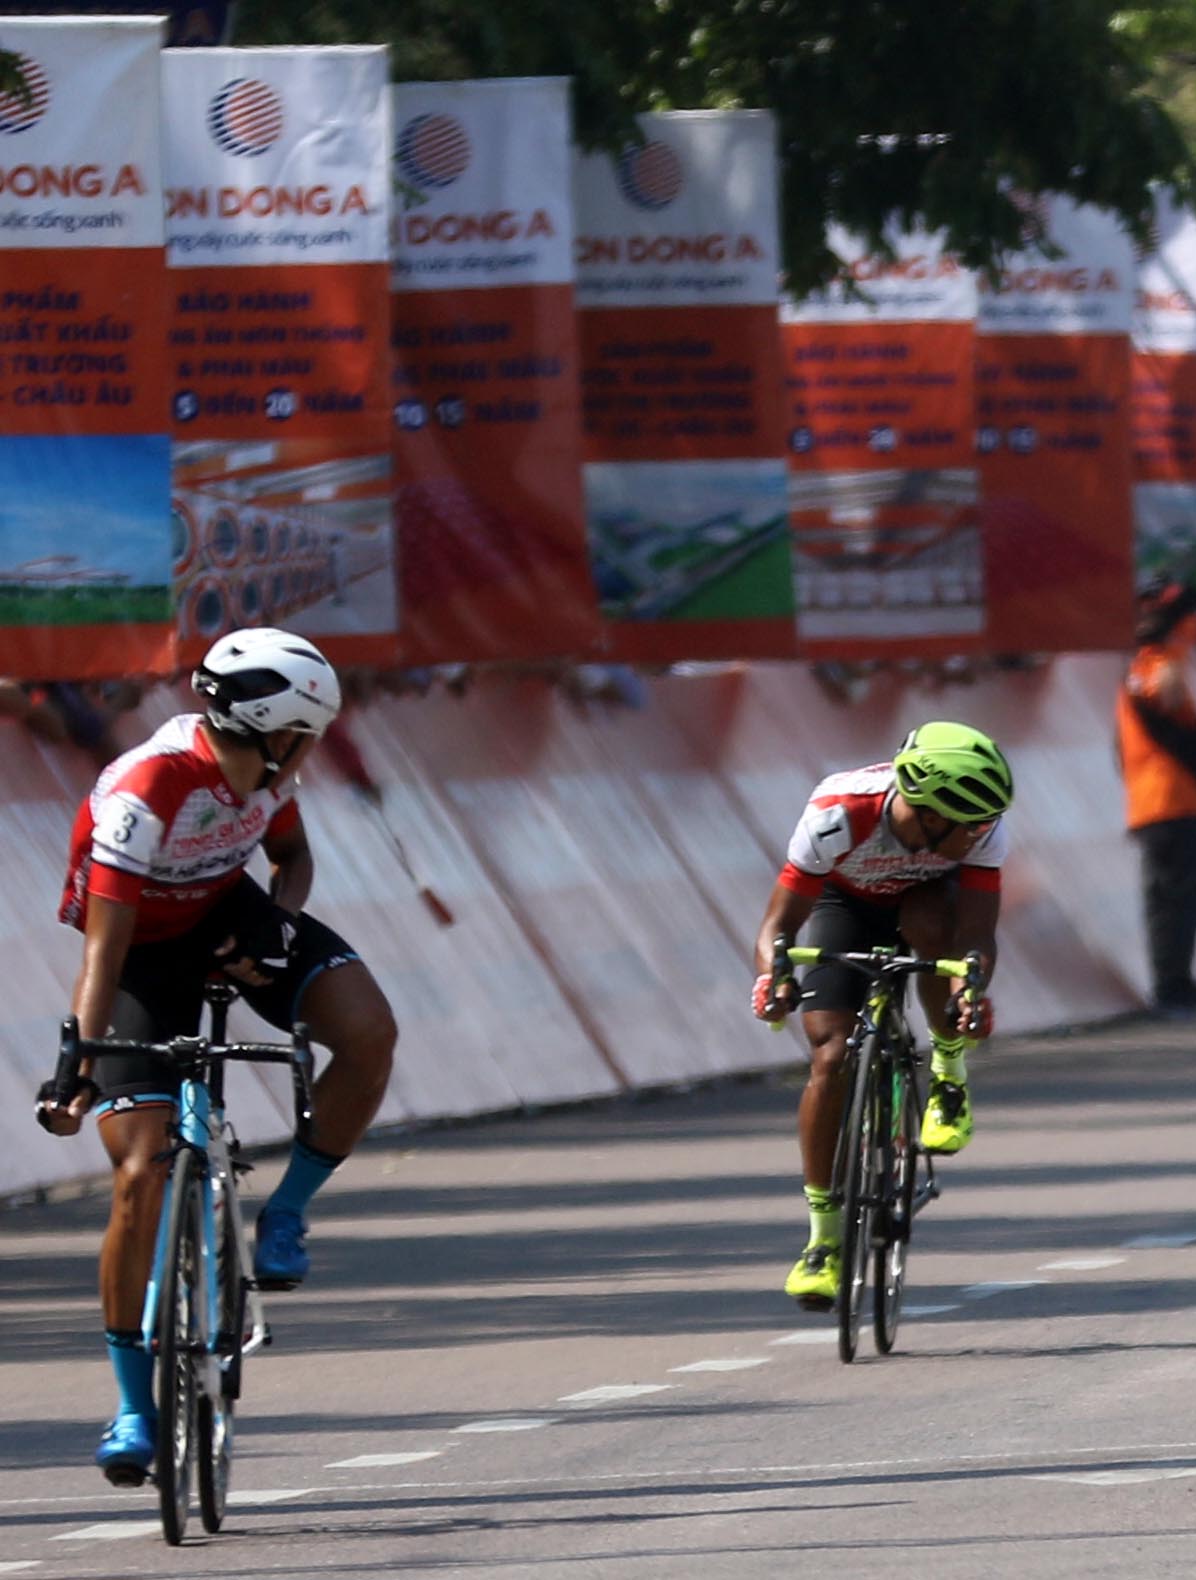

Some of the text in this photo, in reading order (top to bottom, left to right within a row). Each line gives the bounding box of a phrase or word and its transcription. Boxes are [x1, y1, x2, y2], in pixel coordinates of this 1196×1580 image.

[0, 164, 145, 198] ONG A
[218, 184, 332, 218] DONG
[339, 184, 369, 216] A
[406, 208, 555, 246] DONG A
[627, 234, 725, 264] DONG
[735, 233, 764, 262] A
[113, 812, 138, 844] 3
[815, 819, 843, 843] 1
